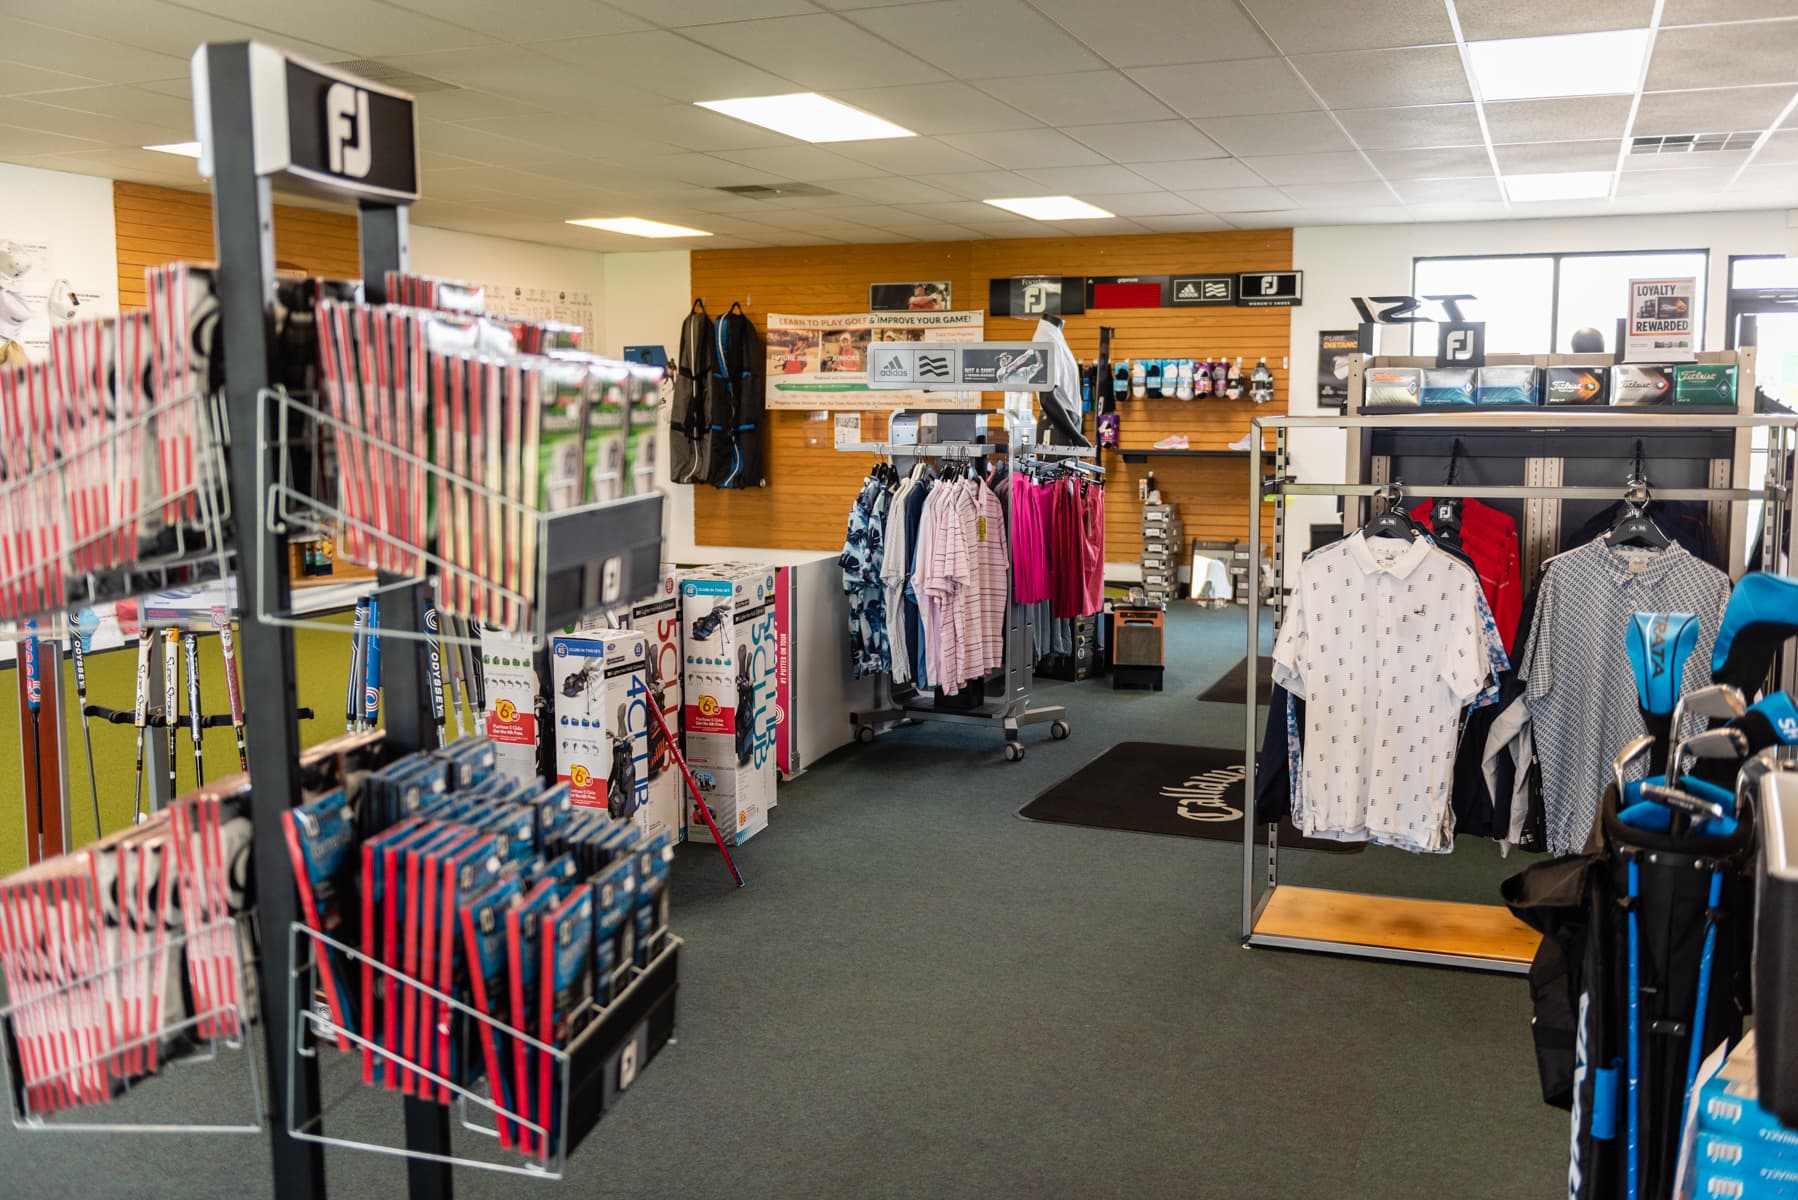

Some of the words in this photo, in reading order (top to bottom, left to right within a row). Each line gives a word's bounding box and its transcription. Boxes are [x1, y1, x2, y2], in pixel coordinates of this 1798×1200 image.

[326, 81, 371, 179] FJ
[1260, 275, 1278, 295] FJ
[1637, 284, 1677, 297] LOYALTY
[1024, 287, 1047, 314] FJ
[778, 317, 806, 326] LEARN
[806, 319, 820, 327] TO
[820, 319, 843, 327] PLAY
[844, 317, 867, 326] GOLF
[869, 316, 875, 324] &
[877, 316, 915, 325] IMPROVE
[915, 315, 941, 325] YOUR
[942, 315, 971, 324] GAME!
[1635, 320, 1689, 332] REWARDED
[1323, 341, 1358, 349] DISTANC
[1446, 330, 1475, 361] FJ
[880, 368, 908, 377] adidas
[1651, 612, 1671, 680] TRATA
[74, 640, 86, 687] ODYSSEY
[779, 656, 787, 677] PUTTER
[431, 652, 445, 714] ODYSSEY
